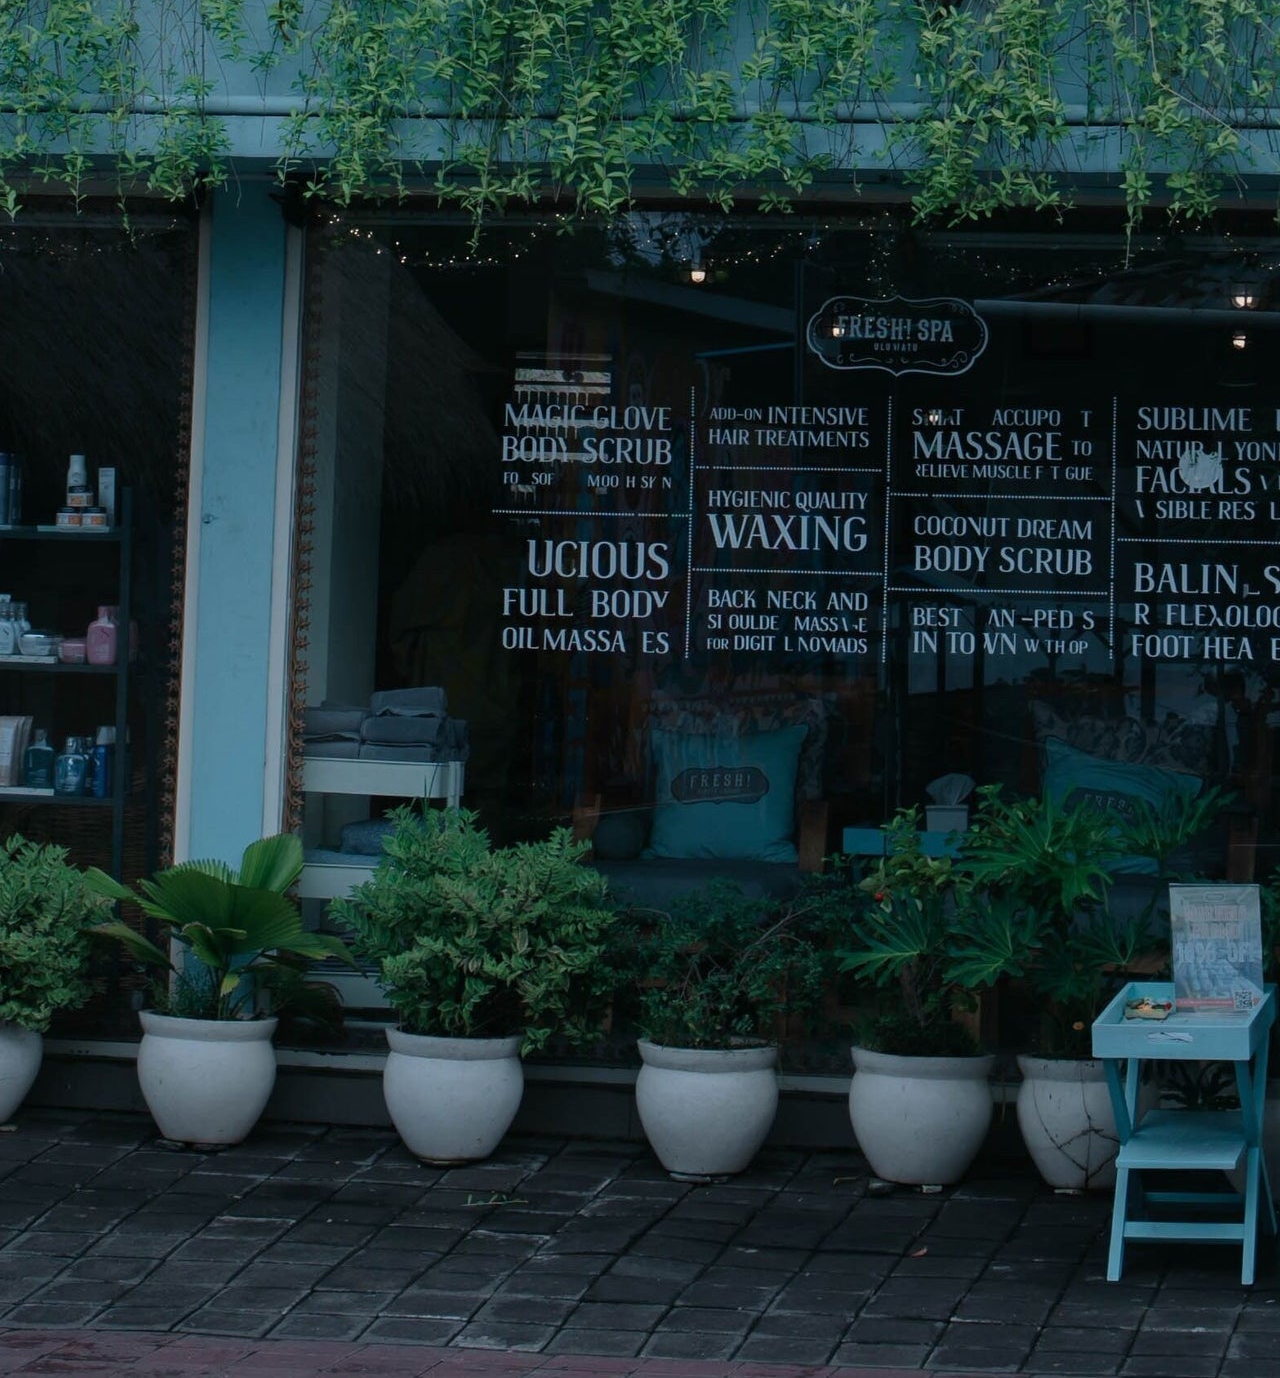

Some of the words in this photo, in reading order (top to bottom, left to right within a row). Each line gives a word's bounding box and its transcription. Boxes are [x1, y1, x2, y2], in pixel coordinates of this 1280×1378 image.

[837, 315, 912, 341] FRESH!
[918, 319, 955, 343] SPA
[504, 403, 586, 428] MAGIC
[592, 405, 672, 431] GLOVE
[709, 407, 763, 421] ADD-ON
[768, 406, 870, 426] INTENSIVE
[1136, 406, 1253, 433] SUBLIME
[708, 428, 750, 446] HAIR
[754, 429, 870, 448] TREATMENTS
[912, 431, 1063, 461] MASSAGE
[1071, 440, 1093, 456] TO
[582, 437, 673, 465] SCRUB
[972, 465, 1032, 480] MUSCLE
[708, 489, 791, 509] HYGIENIC
[795, 491, 869, 513] QUALITY
[706, 513, 869, 552] WAXING
[914, 515, 1011, 538] COCONUT
[1017, 518, 1093, 540] DREAM
[526, 539, 670, 580] UCIOUS
[913, 545, 991, 572] BODY
[998, 546, 1094, 575] SCRUB
[502, 588, 574, 617] FULL
[707, 589, 757, 609] BACK
[767, 590, 817, 610] NECK
[826, 592, 869, 612] AND
[912, 607, 964, 627] BEST
[502, 626, 540, 650] OIL
[543, 628, 671, 654] MASSAES
[706, 637, 730, 650] FOR
[734, 635, 794, 652] DIGITL
[912, 631, 938, 654] IN
[1132, 634, 1194, 658] FOOT
[689, 773, 751, 789] FRESH!
